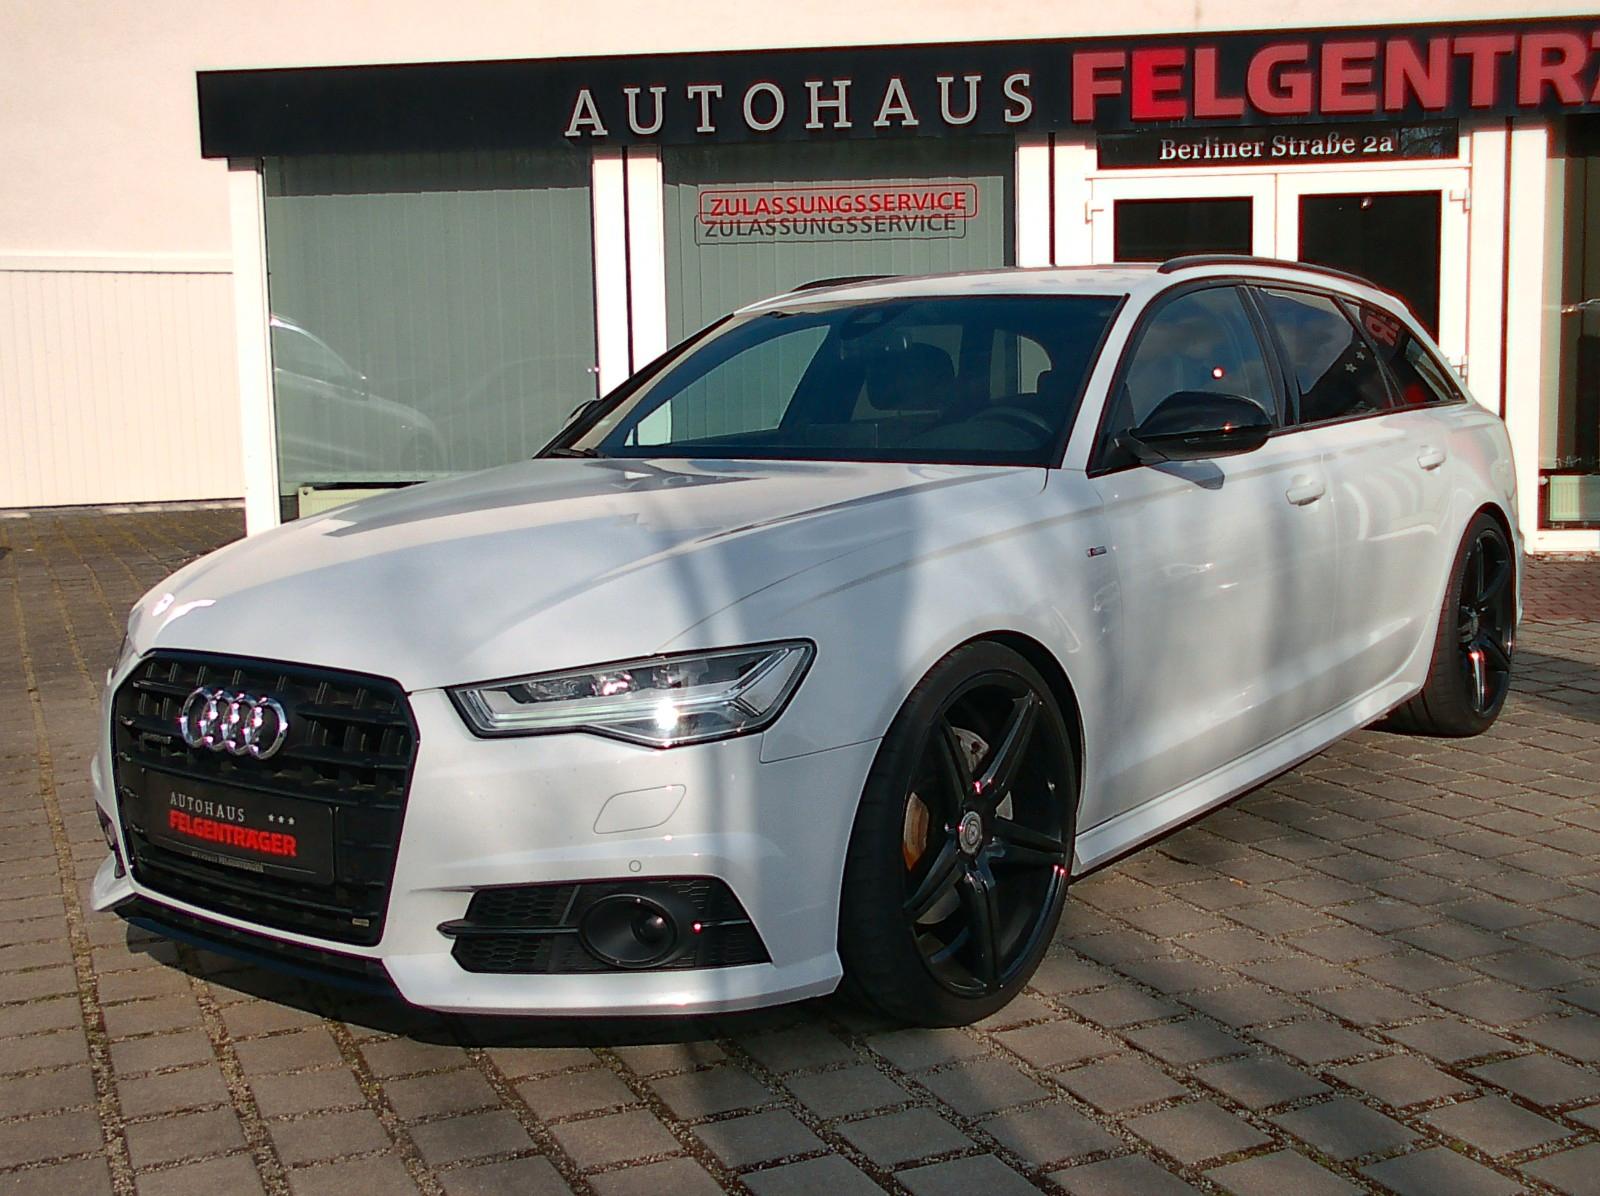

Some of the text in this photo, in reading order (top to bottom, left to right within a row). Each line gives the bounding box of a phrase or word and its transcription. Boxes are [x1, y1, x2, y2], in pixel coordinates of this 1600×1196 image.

[564, 30, 1600, 137] AUTOHAUS FELGENTR
[1159, 132, 1394, 161] Berliner Straße 2a
[710, 192, 967, 217] ZULASSUNGSSERVICE
[705, 213, 957, 238] ZULASSUNGSSERVICE
[169, 791, 245, 823] AUTOHAUS
